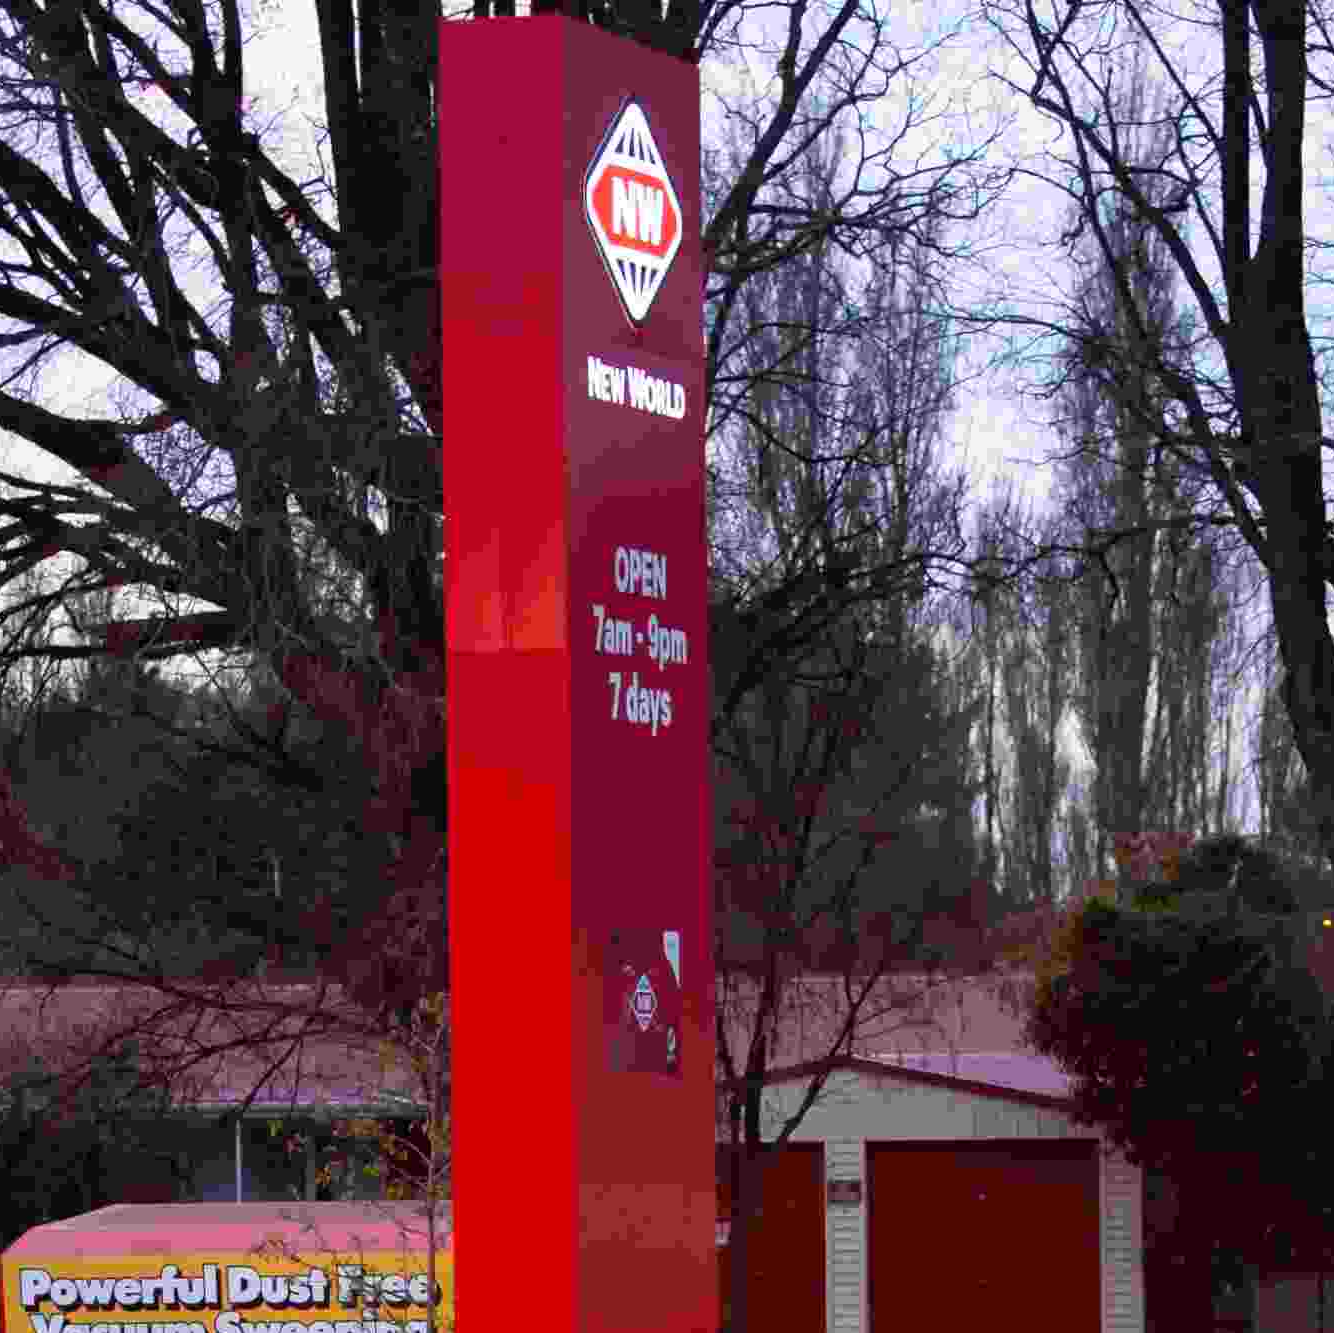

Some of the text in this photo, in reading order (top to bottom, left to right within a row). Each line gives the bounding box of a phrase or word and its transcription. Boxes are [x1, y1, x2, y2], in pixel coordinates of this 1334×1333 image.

[586, 355, 686, 418] NEW WORLD
[615, 546, 667, 600] OPEN
[593, 603, 633, 656] 7am
[648, 613, 687, 672] 9pm
[609, 671, 672, 736] 7 days
[20, 1264, 441, 1308] Powerful Dust Free
